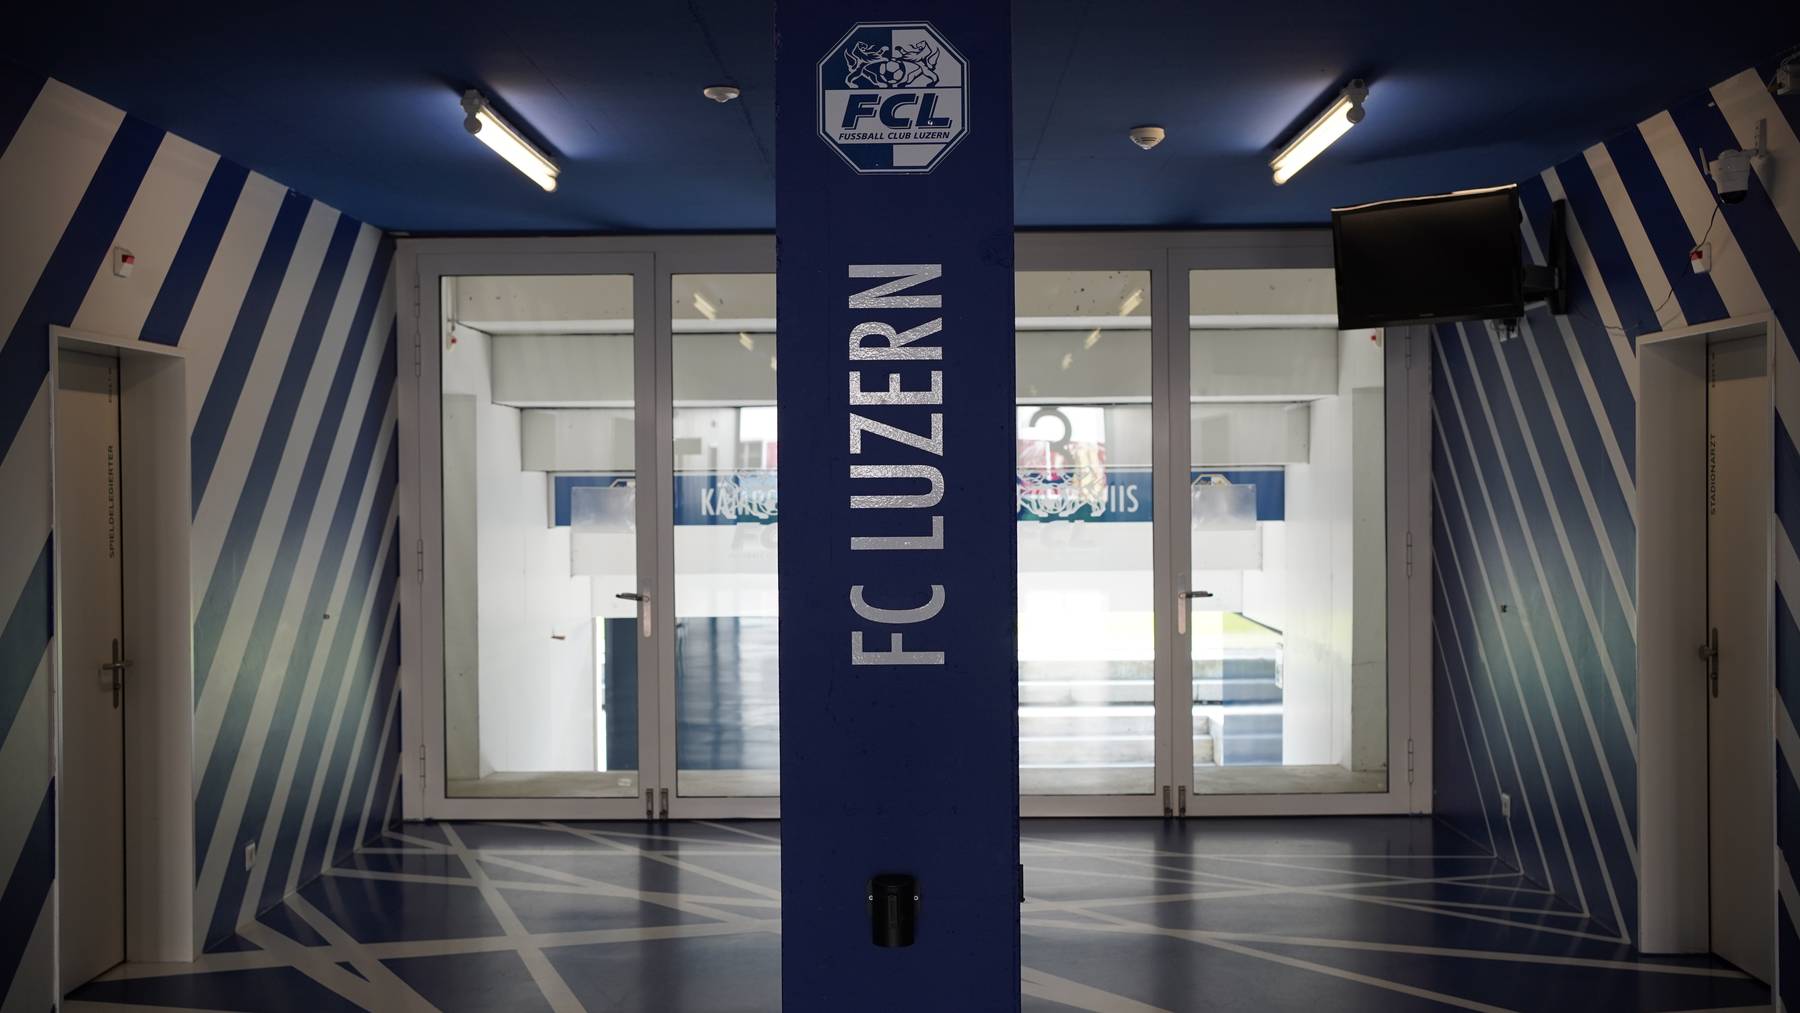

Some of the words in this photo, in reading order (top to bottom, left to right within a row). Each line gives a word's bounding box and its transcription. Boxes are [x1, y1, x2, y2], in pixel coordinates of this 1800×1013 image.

[838, 132, 885, 141] FUSSBALL
[887, 132, 912, 140] CLUB
[913, 131, 950, 139] LUZERN
[841, 93, 952, 130] FCL
[848, 263, 945, 550] LUZERN
[849, 584, 946, 665] FC
